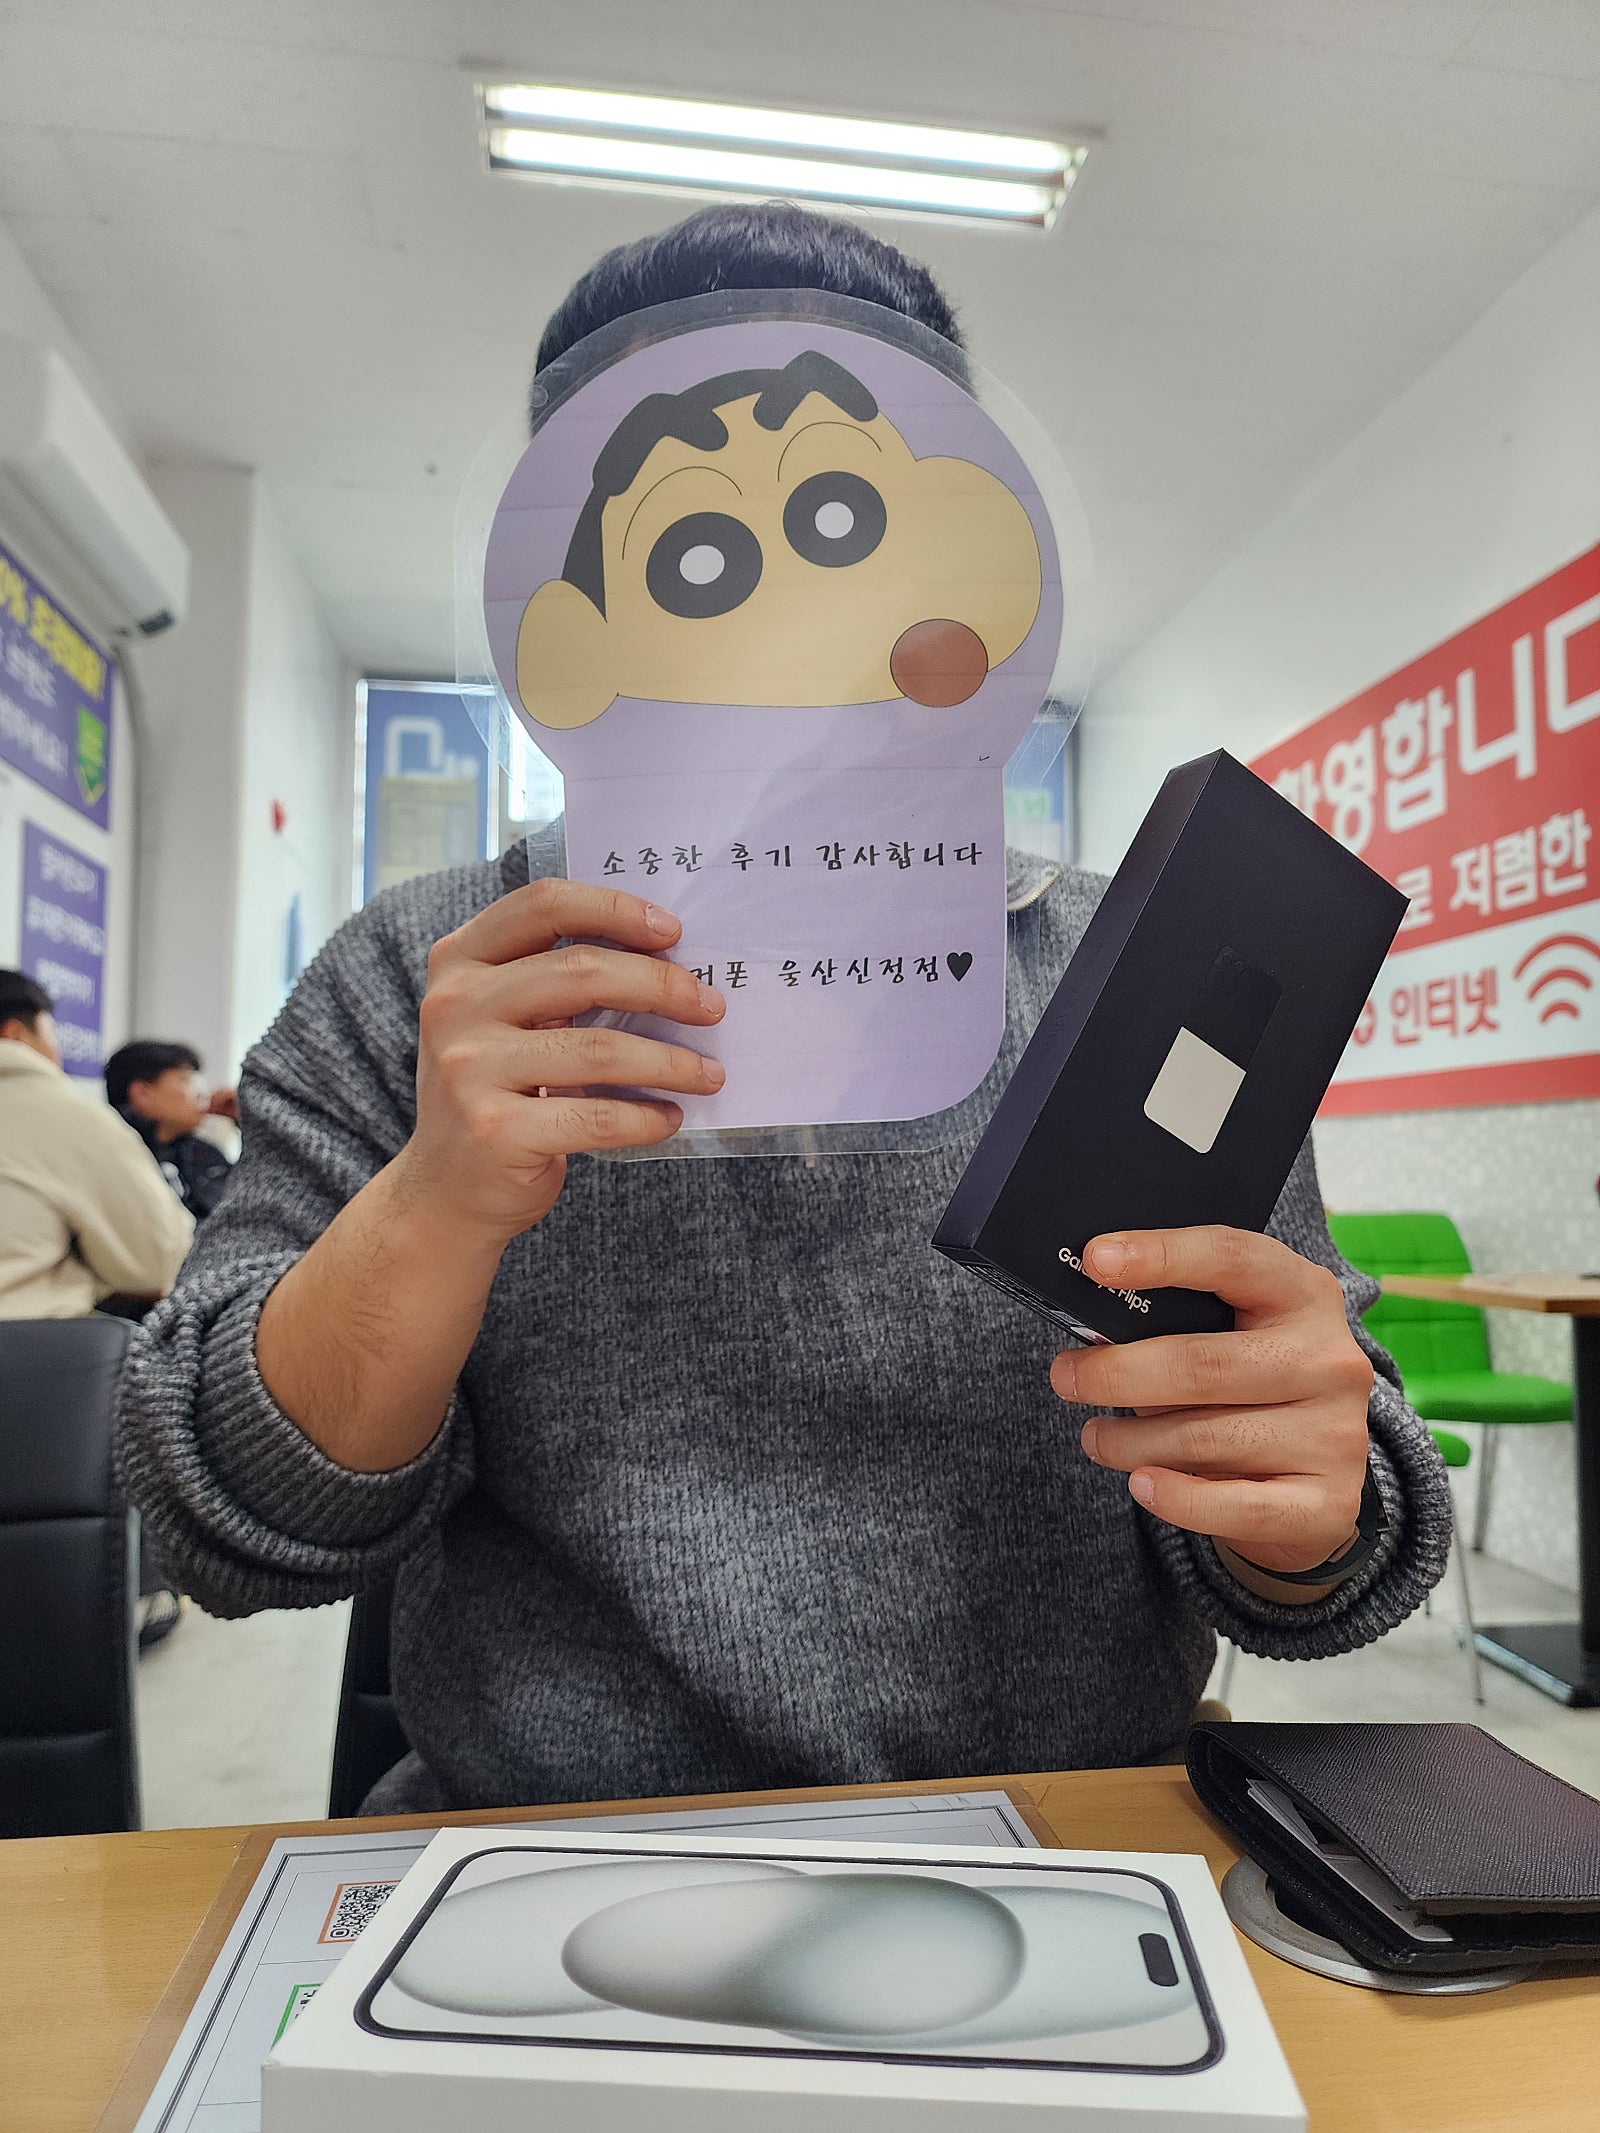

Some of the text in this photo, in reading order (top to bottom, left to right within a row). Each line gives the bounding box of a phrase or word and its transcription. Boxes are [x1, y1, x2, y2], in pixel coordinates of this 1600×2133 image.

[603, 841, 983, 875] 소중한 후기 감사합니다
[1448, 808, 1592, 917] 저렴한
[778, 955, 939, 987] 울산신정점
[1390, 966, 1499, 1046] 인터넷
